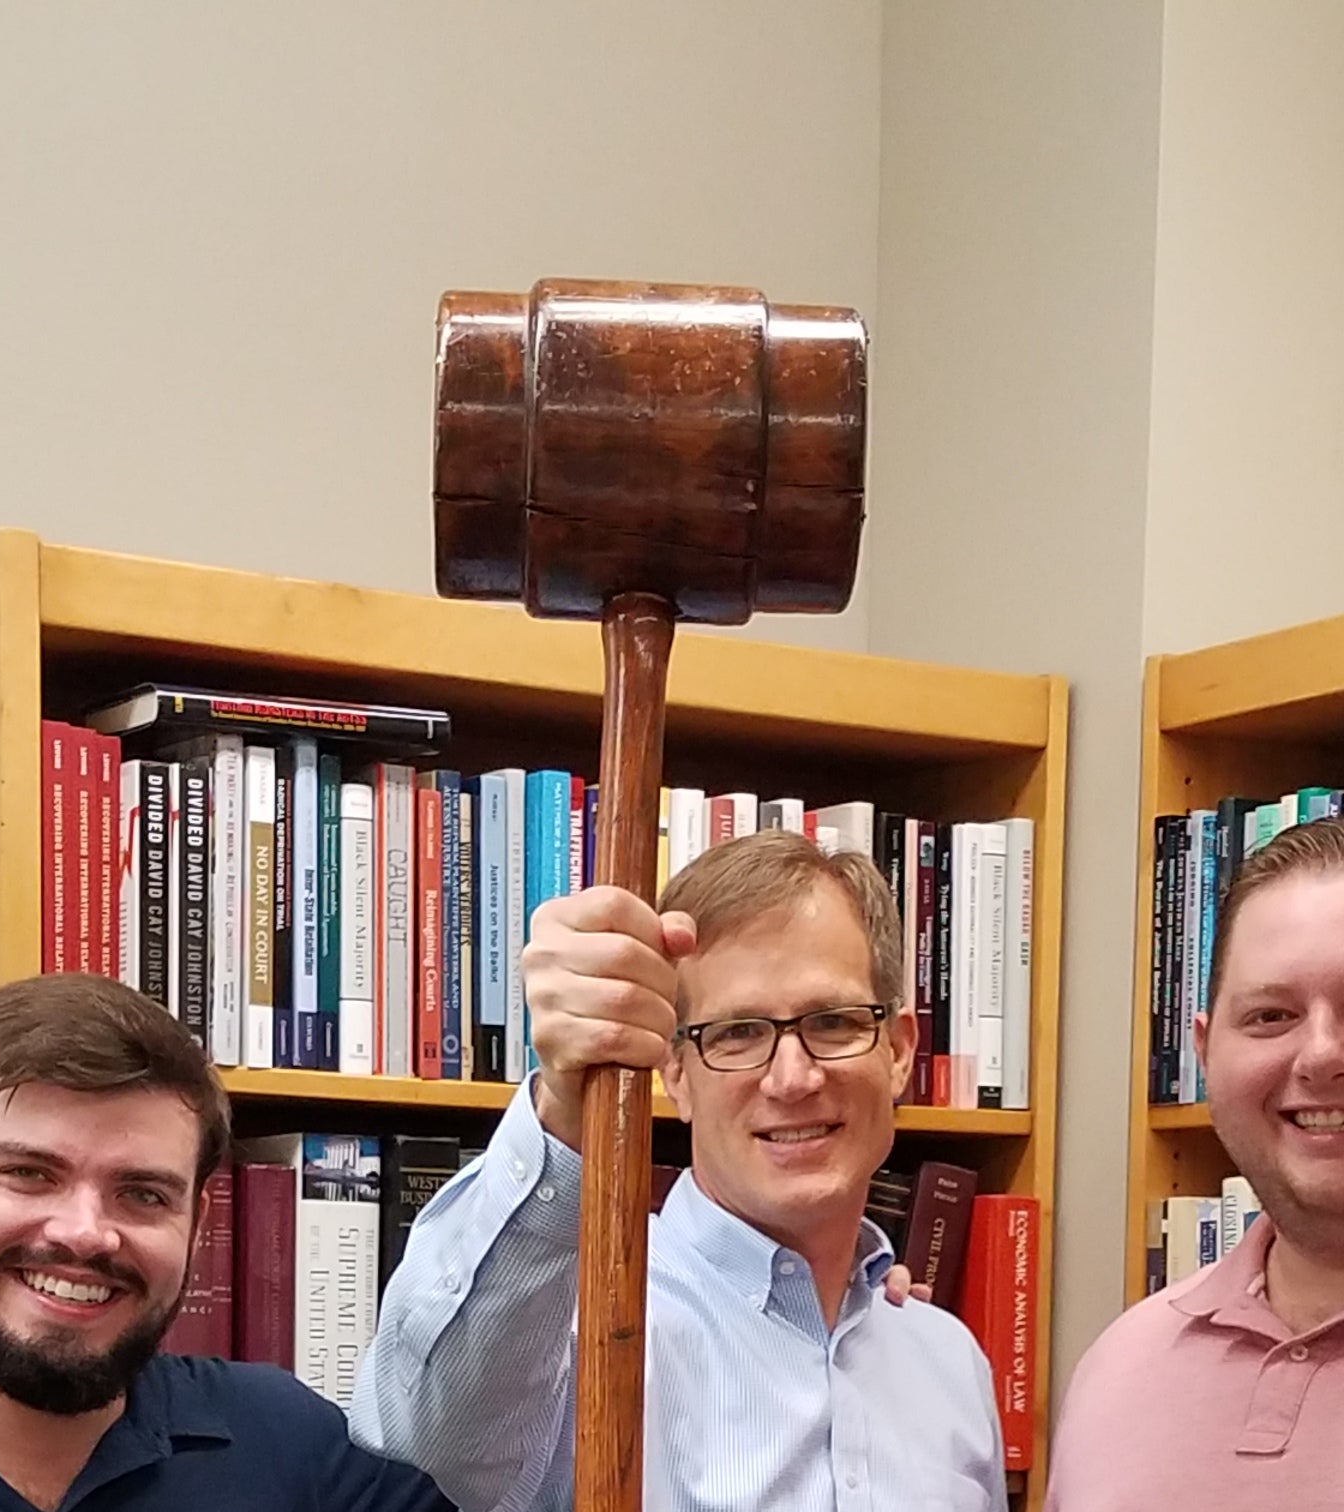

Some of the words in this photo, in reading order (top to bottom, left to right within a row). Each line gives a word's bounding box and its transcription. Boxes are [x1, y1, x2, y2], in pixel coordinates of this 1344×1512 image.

[54, 783, 63, 851] RECOVERING
[80, 790, 89, 856] RECOVERING
[147, 774, 164, 843] DIVIDED
[187, 778, 203, 846] DIVIDED
[275, 778, 285, 821] RADICAL
[442, 786, 451, 826] ACCESS
[102, 796, 111, 862] RECOVERING
[354, 830, 367, 870] Black
[569, 810, 583, 896] TRAFFICKIN
[147, 849, 164, 899] DAVID
[187, 852, 203, 902] DAVID
[255, 846, 268, 872] NO
[442, 843, 451, 885] JUSTICE
[992, 865, 1003, 900] Black
[54, 852, 64, 934] INTERNATIONAL
[80, 858, 89, 939] INTERNATIONAL
[102, 864, 111, 945] INTERNATIONAL
[254, 874, 269, 906] DAY
[354, 878, 367, 918] Silent
[386, 848, 408, 949] CAUGHT
[489, 864, 500, 909] Justices
[512, 832, 522, 939] LIBERALIZING
[147, 905, 163, 936] CAY
[187, 907, 203, 938] CAY
[255, 909, 268, 922] IN
[275, 904, 285, 931] TRIAL
[423, 889, 438, 967] Reimagining
[490, 912, 498, 927] on
[490, 929, 500, 948] the
[991, 907, 1002, 944] Silent
[147, 941, 163, 1001] JOHNST
[254, 925, 269, 984] COURT
[352, 925, 367, 989] Majority
[490, 950, 500, 984] Ballot
[989, 949, 1002, 1007] Majority
[186, 943, 203, 1026] JOHNSTON
[423, 969, 438, 1011] Courts
[512, 944, 522, 1022] LYNCHING
[407, 1175, 448, 1190] WEST'
[930, 1217, 946, 1252] CIVIL
[1014, 1210, 1029, 1287] ECONOMIC
[337, 1227, 360, 1334] SUPREME
[924, 1256, 940, 1288] PRO
[308, 1269, 330, 1340] UNITED
[364, 1302, 375, 1350] COMPAN
[1013, 1290, 1028, 1354] ANALYSIS
[307, 1347, 329, 1394] STAT
[1013, 1356, 1027, 1376] OF
[1012, 1381, 1026, 1413] LAW
